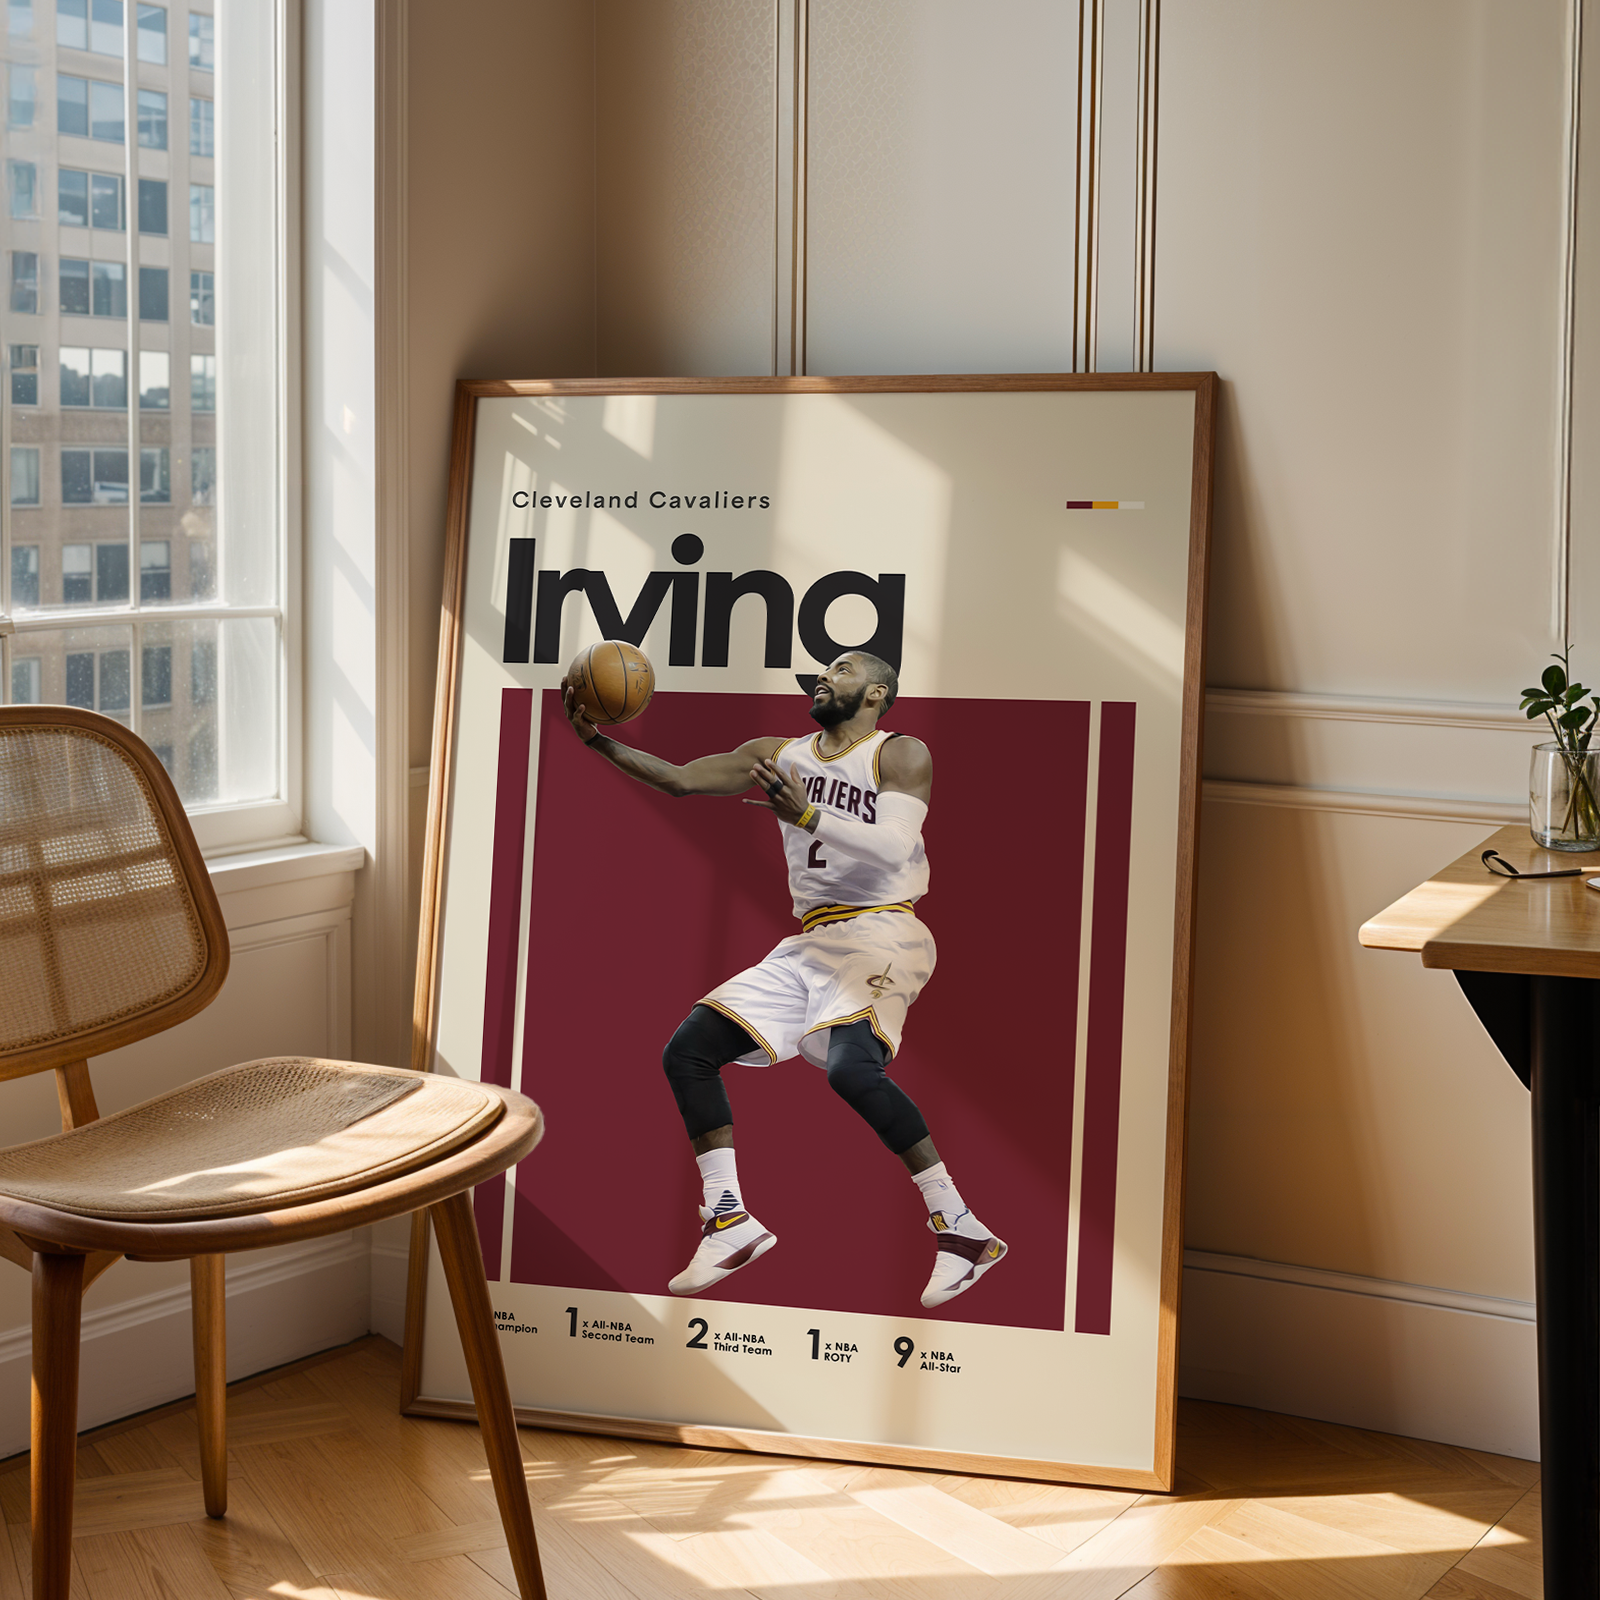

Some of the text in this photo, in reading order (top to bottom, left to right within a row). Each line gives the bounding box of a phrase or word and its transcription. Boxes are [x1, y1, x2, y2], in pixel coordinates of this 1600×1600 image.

[512, 490, 770, 509] Cleveland Cavaliers
[502, 533, 906, 700] Irving
[494, 1311, 516, 1322] NBA
[565, 1306, 578, 1338] 1
[592, 1320, 633, 1332] All-NBA
[495, 1323, 538, 1334] ampion
[581, 1329, 655, 1345] Second Team
[685, 1317, 709, 1350] 2
[723, 1332, 766, 1344] All-NBA
[713, 1342, 773, 1356] Third Team
[806, 1328, 820, 1360] 1
[835, 1342, 859, 1353] NBA
[893, 1336, 915, 1369] 9
[930, 1351, 955, 1362] NBA
[824, 1352, 852, 1363] ROTY
[919, 1361, 962, 1374] All-Star
